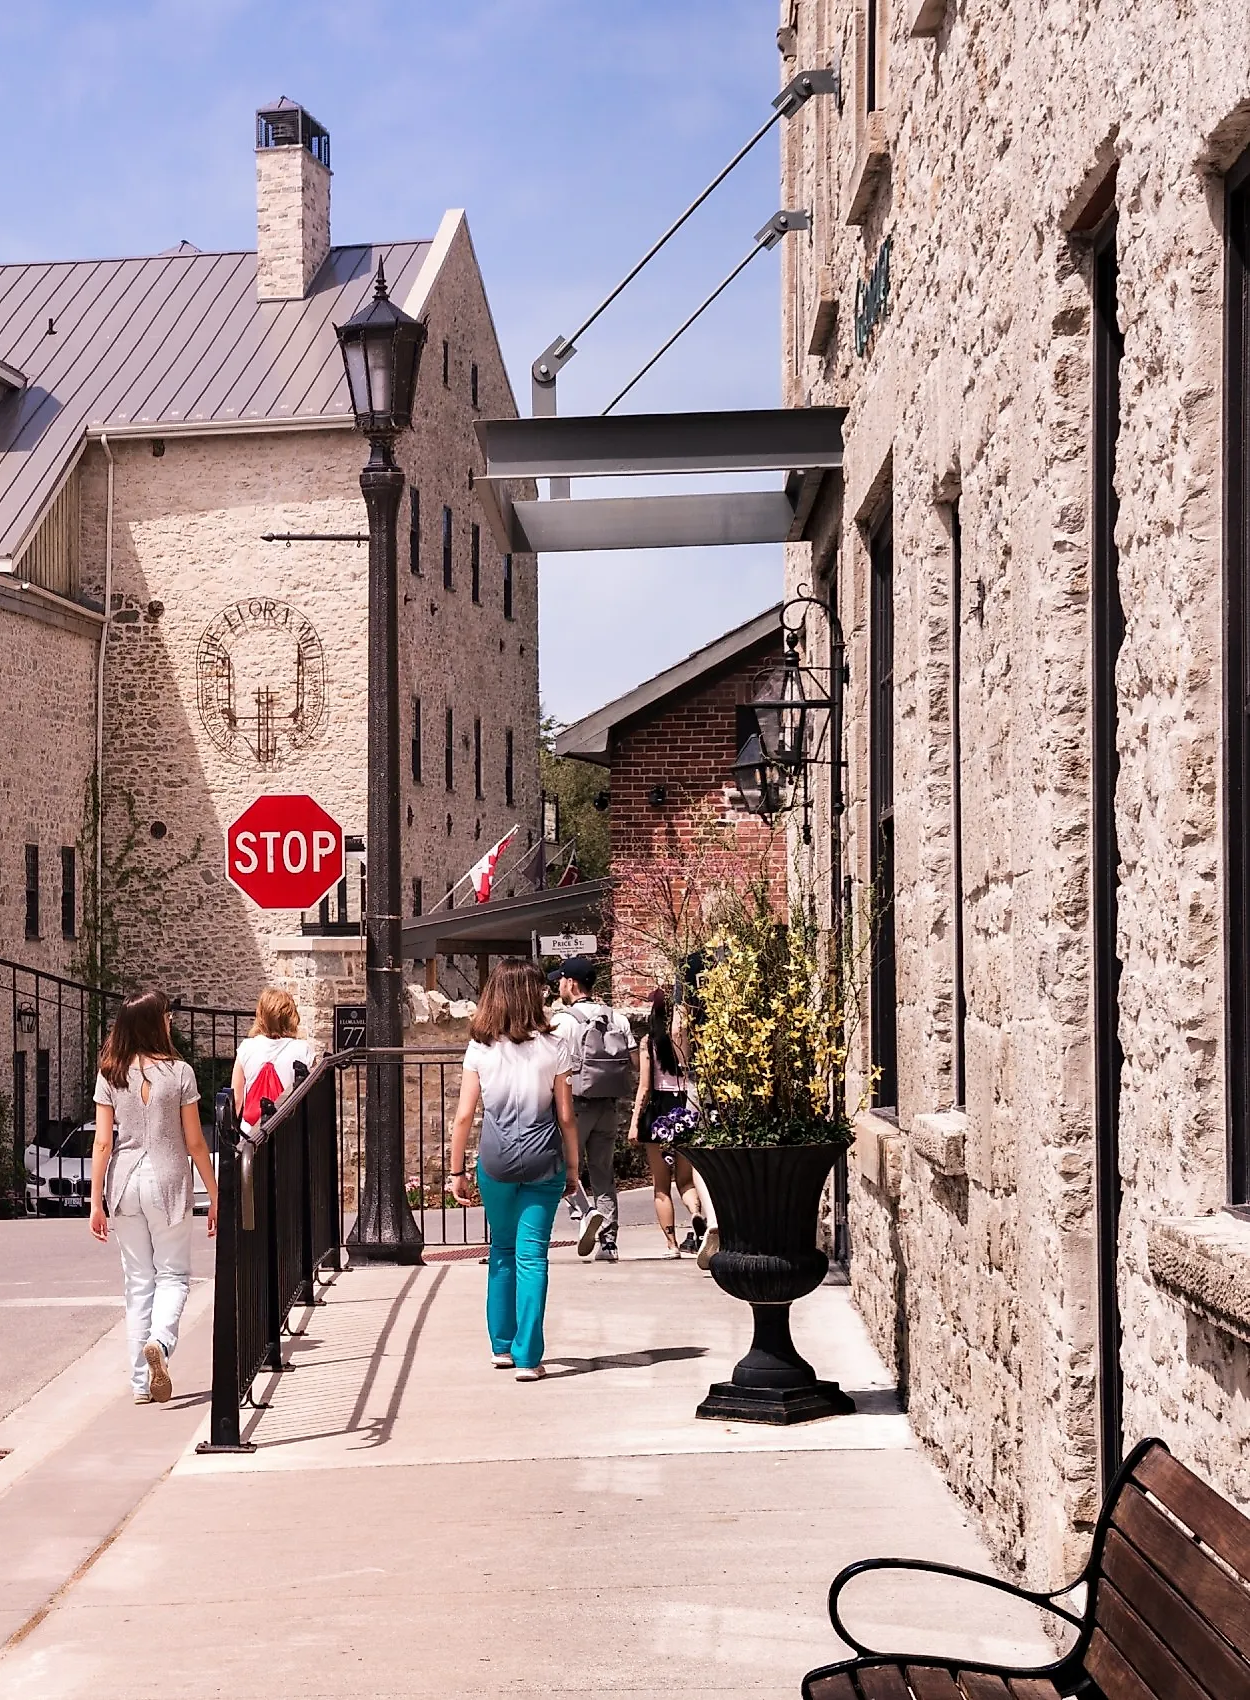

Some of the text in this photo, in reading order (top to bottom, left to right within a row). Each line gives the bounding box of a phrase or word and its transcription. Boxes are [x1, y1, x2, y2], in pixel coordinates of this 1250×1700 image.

[223, 601, 289, 628] ELORA
[234, 830, 336, 874] STOP
[343, 1026, 366, 1046] 77
